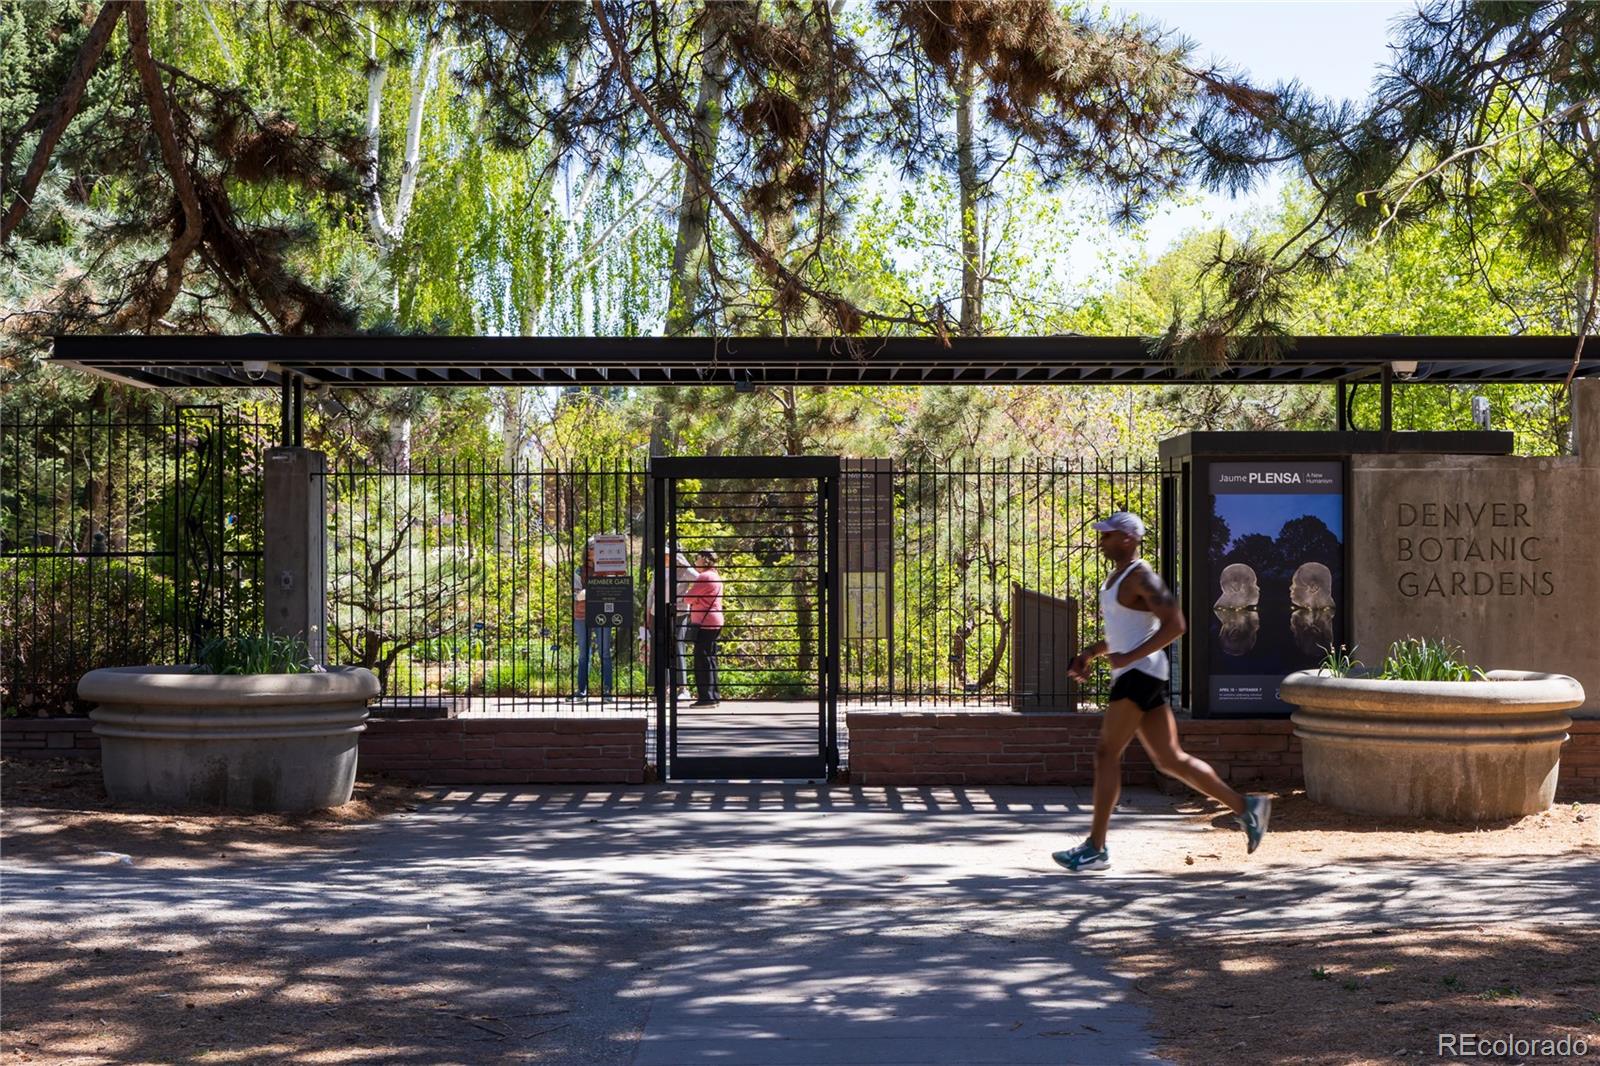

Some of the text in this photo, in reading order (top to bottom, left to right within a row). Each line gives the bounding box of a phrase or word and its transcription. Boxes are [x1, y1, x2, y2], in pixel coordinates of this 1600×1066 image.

[1219, 472, 1301, 484] Jaume PLENSA
[1398, 502, 1531, 528] DENVER
[1398, 536, 1542, 562] BOTANIC
[1397, 571, 1555, 598] GARDENS
